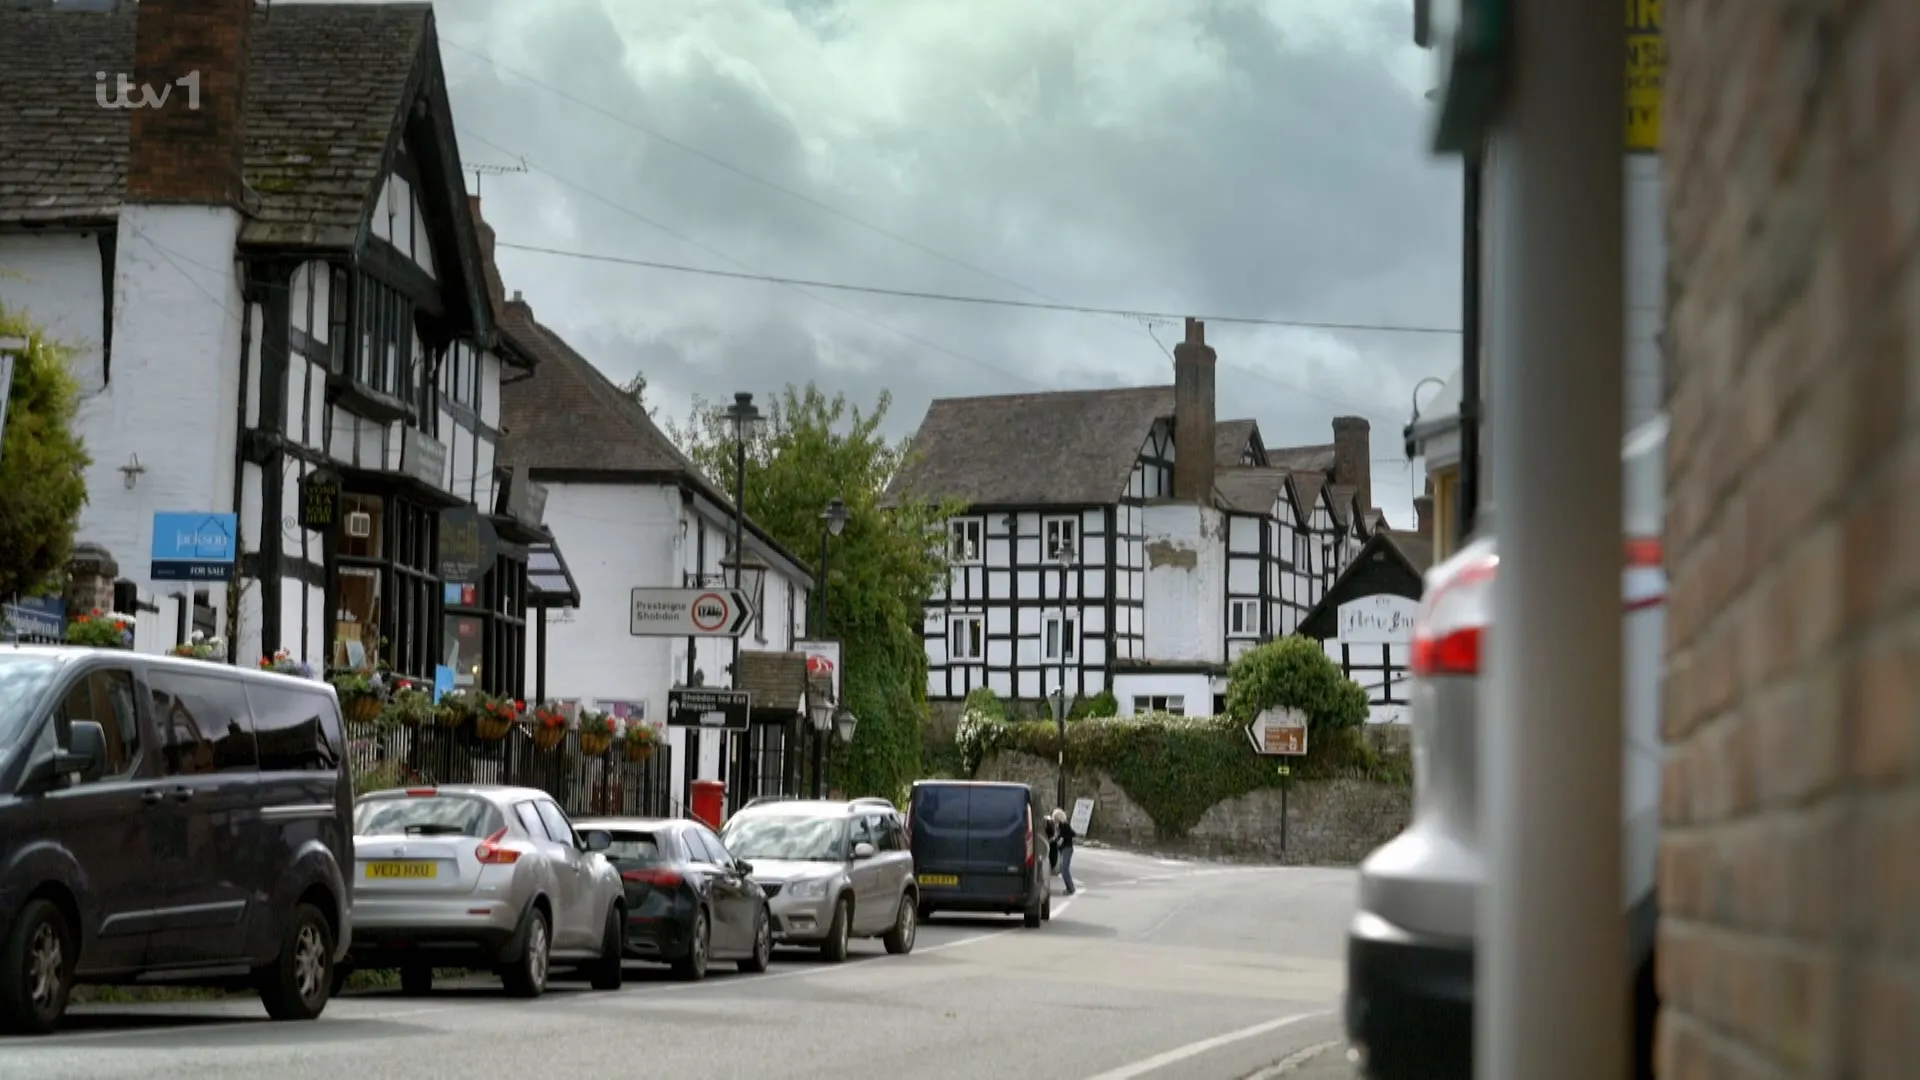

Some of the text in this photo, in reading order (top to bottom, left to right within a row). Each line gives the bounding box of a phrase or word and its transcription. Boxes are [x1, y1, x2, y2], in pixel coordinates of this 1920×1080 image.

[176, 530, 227, 553] jackson
[190, 566, 226, 577] FOR SALE
[636, 601, 687, 611] Presteigne
[636, 612, 680, 621] Shobdon
[681, 692, 717, 702] Shobdon
